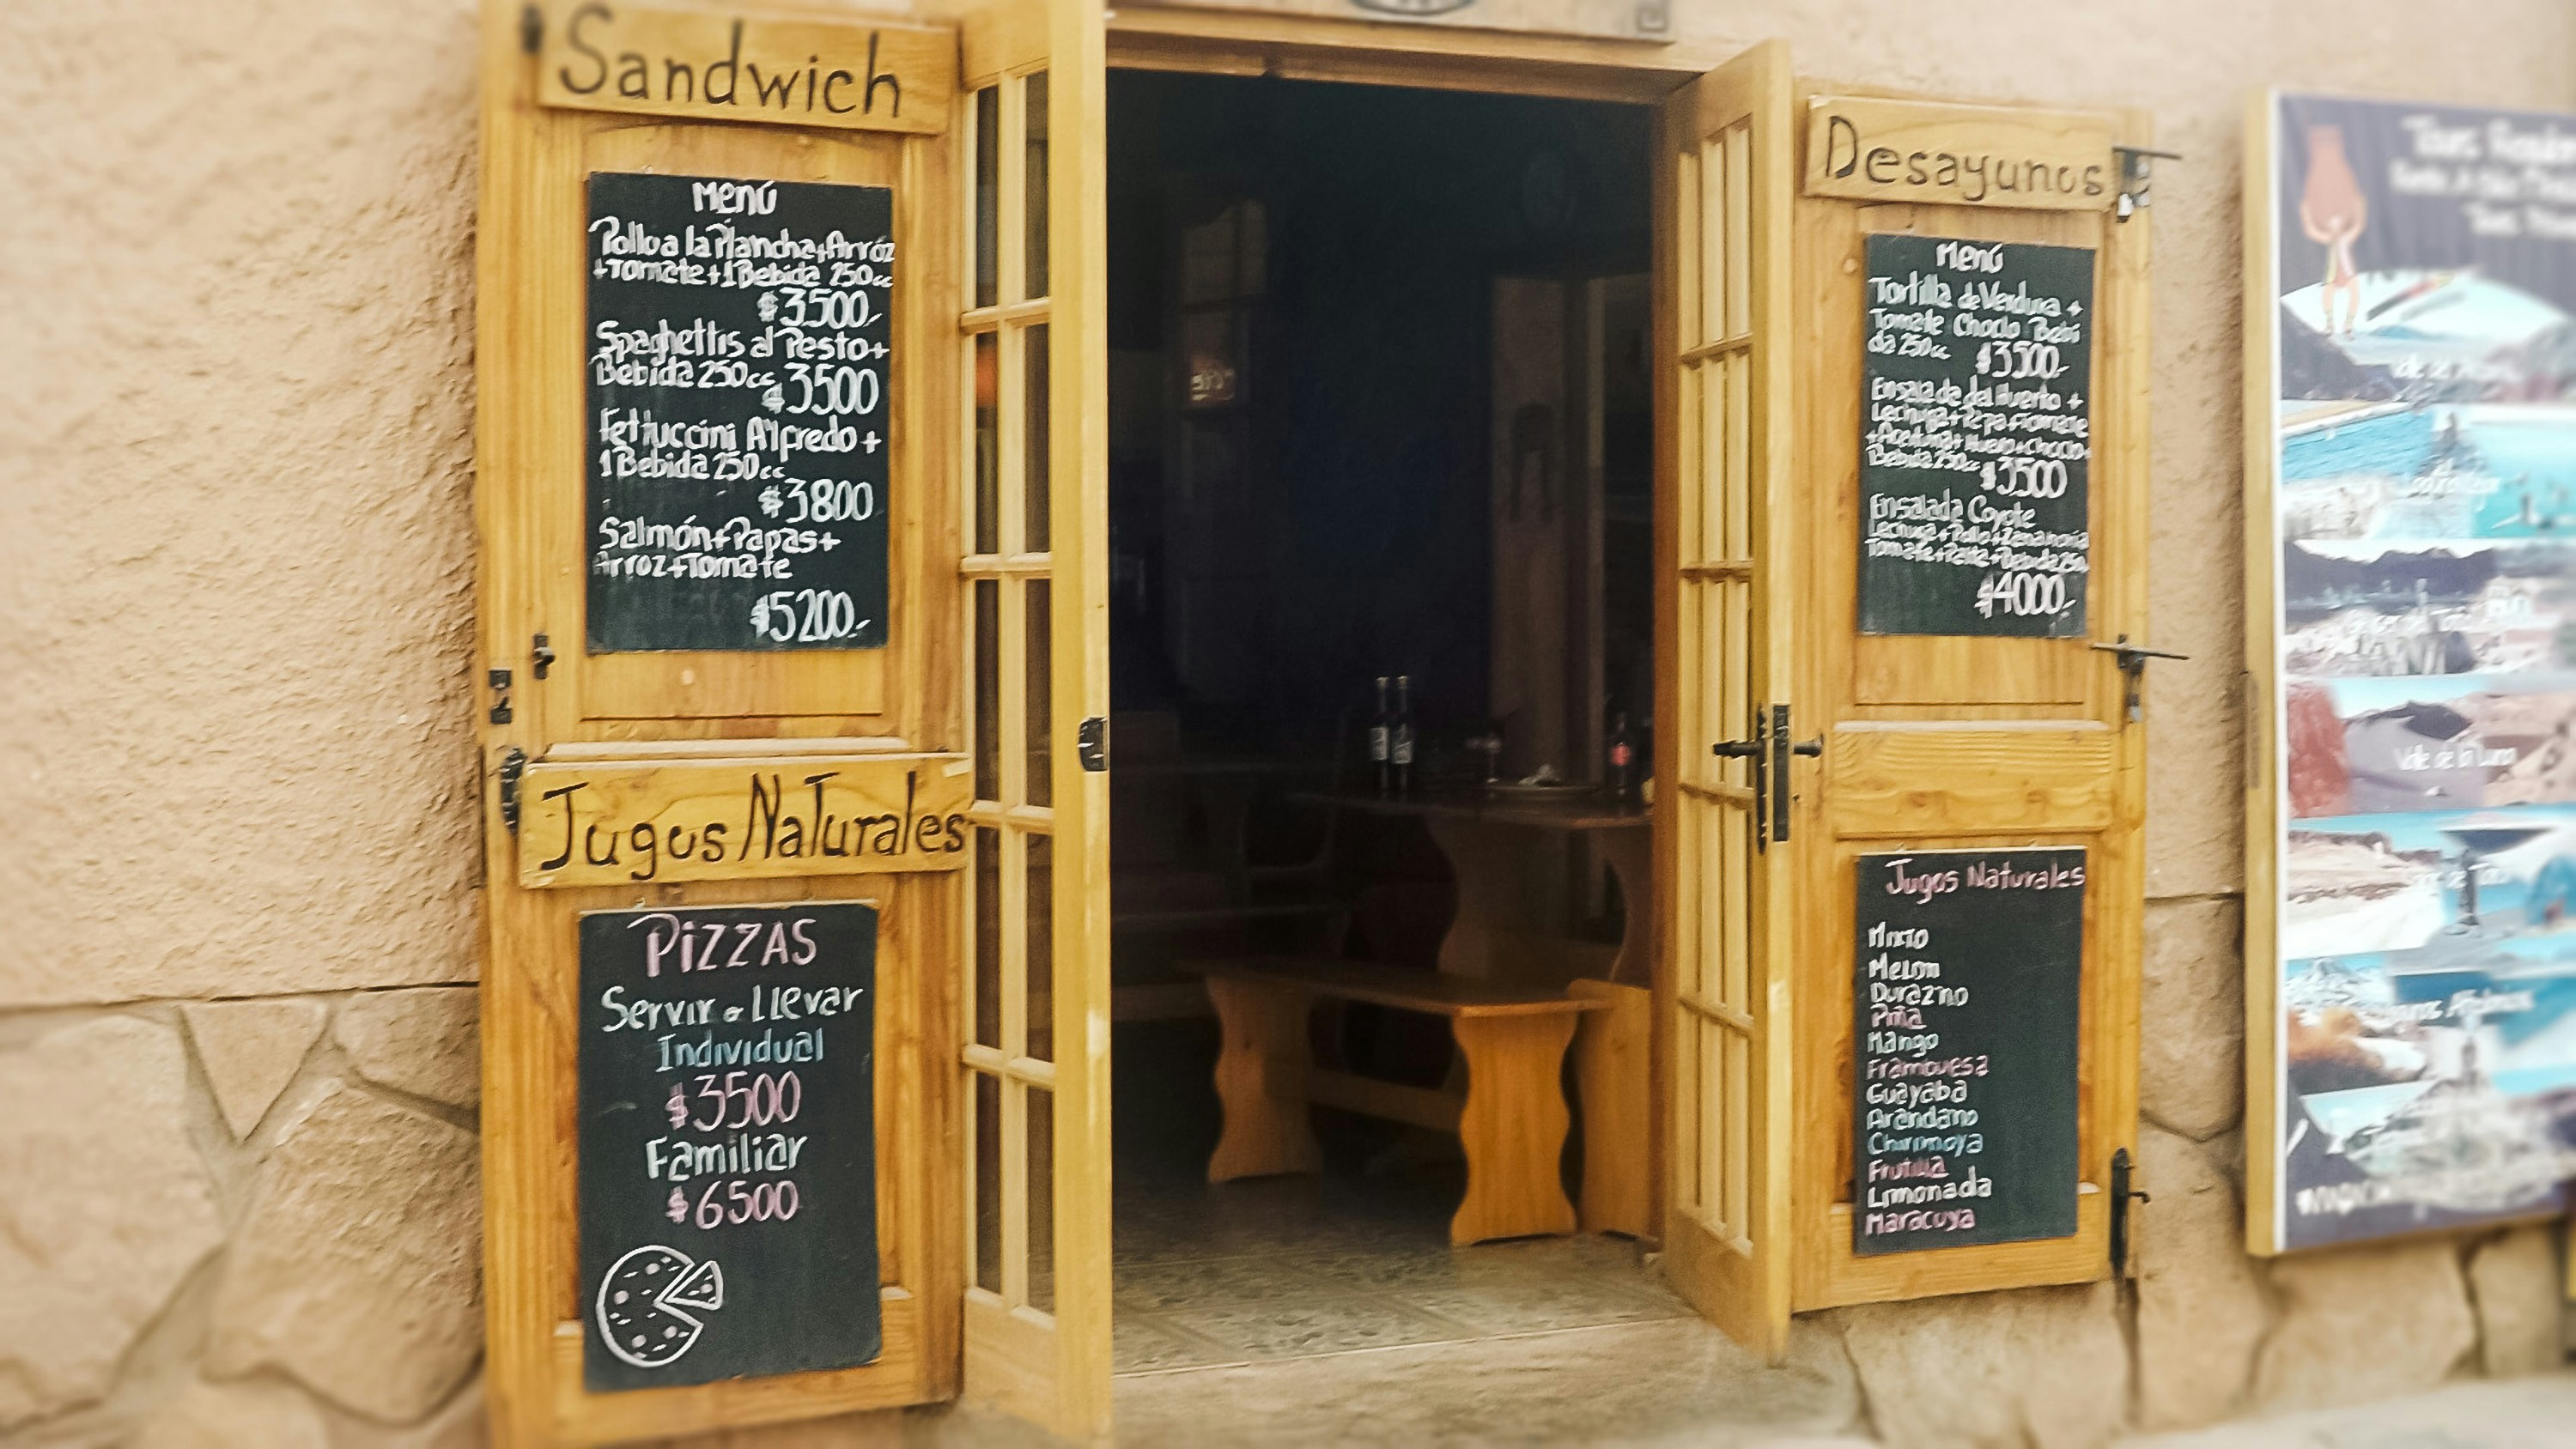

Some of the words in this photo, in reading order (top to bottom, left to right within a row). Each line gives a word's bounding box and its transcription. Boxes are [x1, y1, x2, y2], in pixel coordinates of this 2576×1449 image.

[559, 4, 900, 118] Sandwich
[1826, 115, 2104, 202] Desayunos
[589, 353, 695, 387] Bebida
[540, 781, 728, 882] Jugos
[1885, 858, 1959, 905] Jugos
[1967, 860, 2086, 891] Naturales
[601, 985, 717, 1033] Servir
[655, 1028, 824, 1073] Individual
[1867, 1030, 1939, 1058] Mango
[1866, 1079, 1968, 1109] Guayaba
[646, 1133, 809, 1182] Familiar
[1867, 1165, 1992, 1209] Limonada
